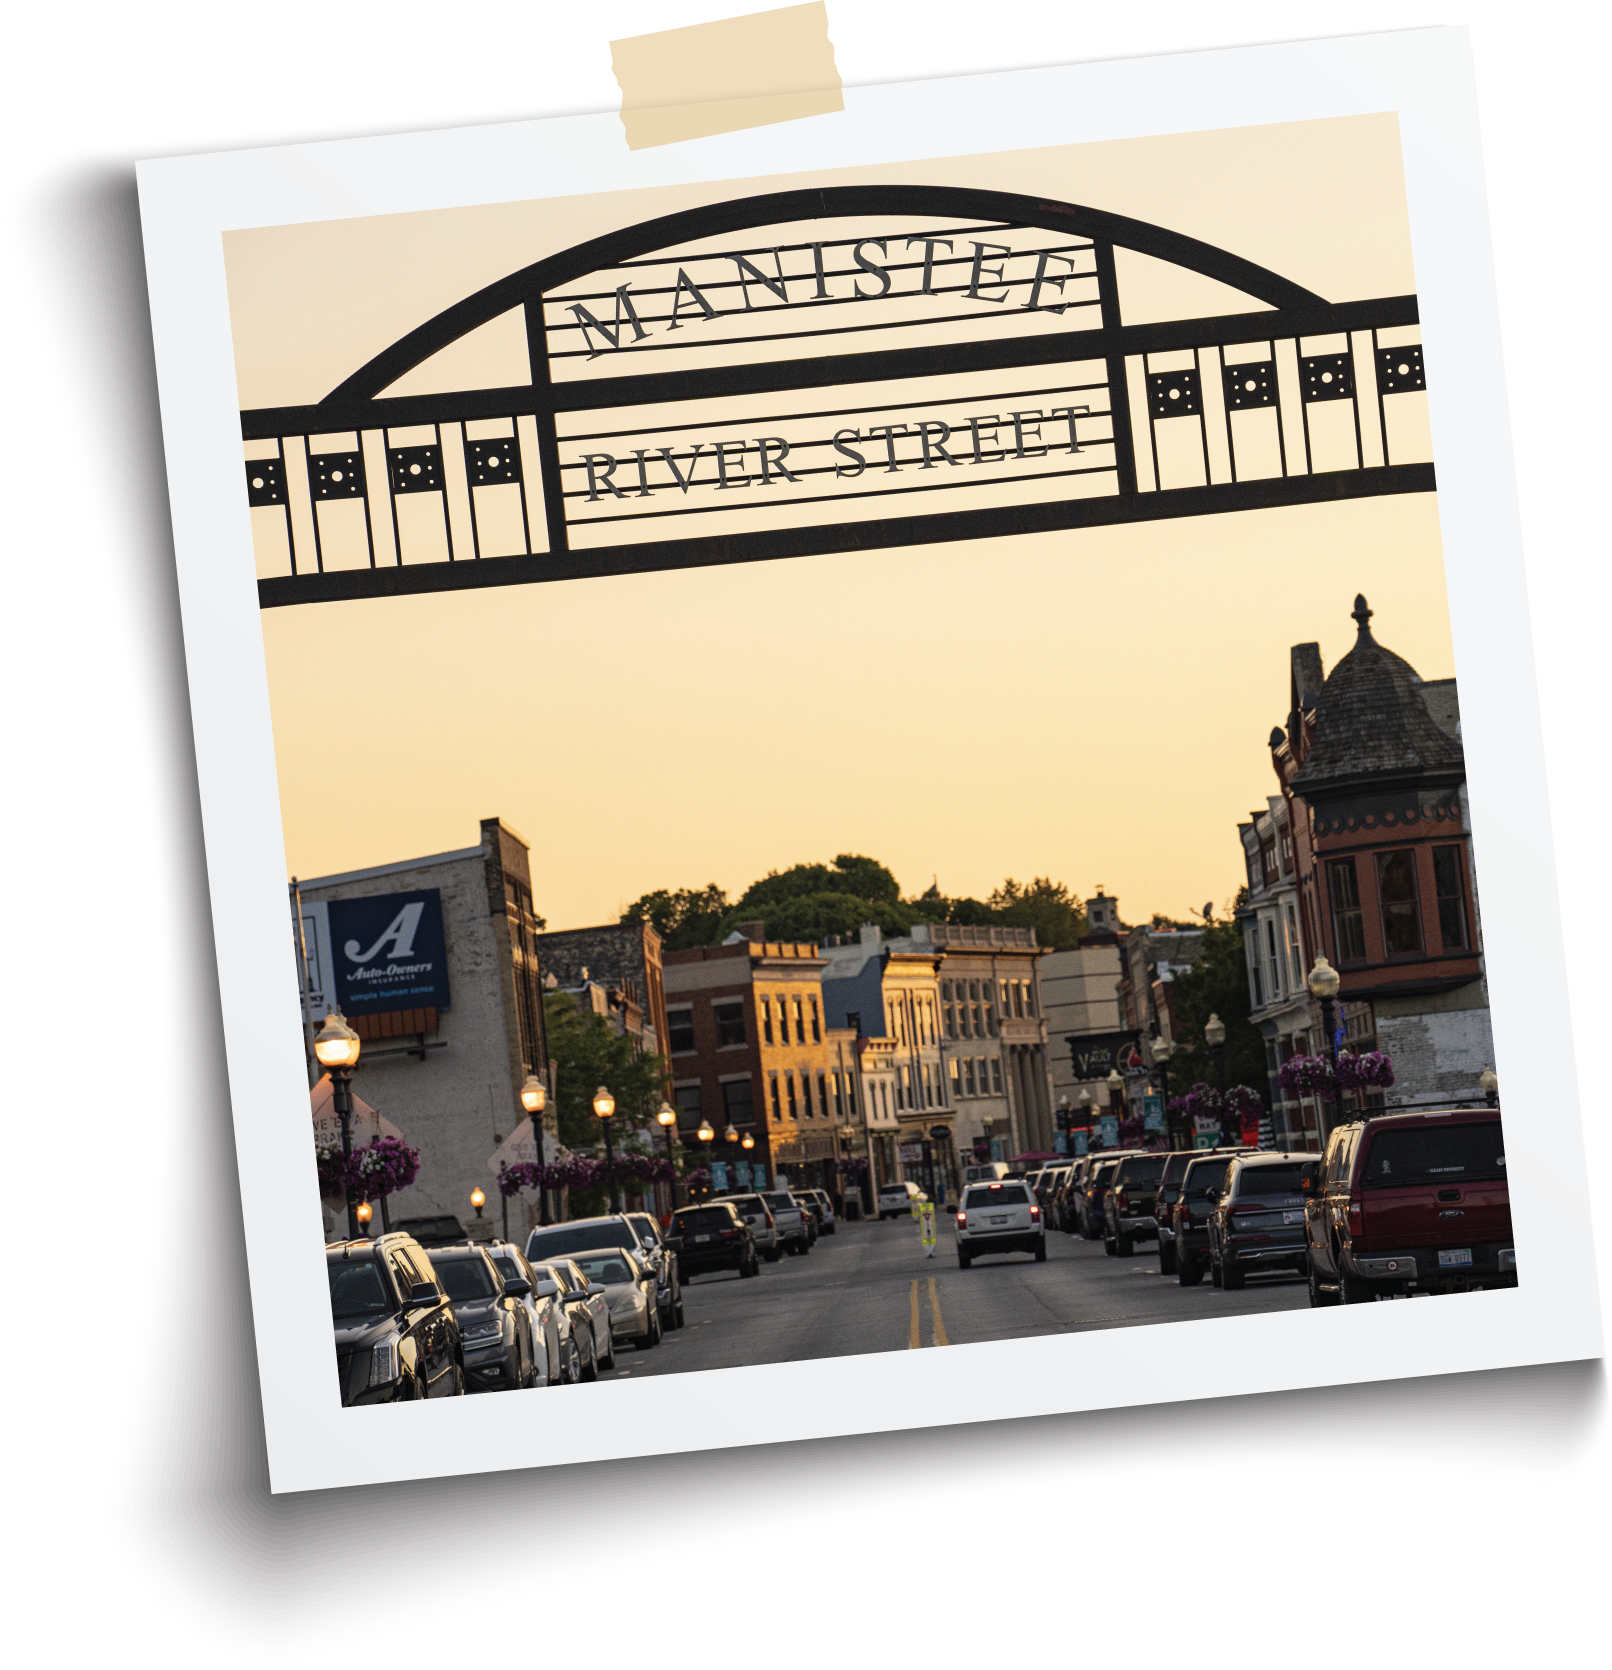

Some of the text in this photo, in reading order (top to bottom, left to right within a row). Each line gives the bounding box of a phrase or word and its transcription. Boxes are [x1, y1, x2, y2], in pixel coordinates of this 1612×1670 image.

[564, 236, 1076, 361] MANISTEE
[578, 405, 1091, 502] RIVER STREET
[346, 962, 433, 981] Auto-Owners
[368, 974, 416, 986] INSURANCE
[350, 985, 435, 1002] simple human sense
